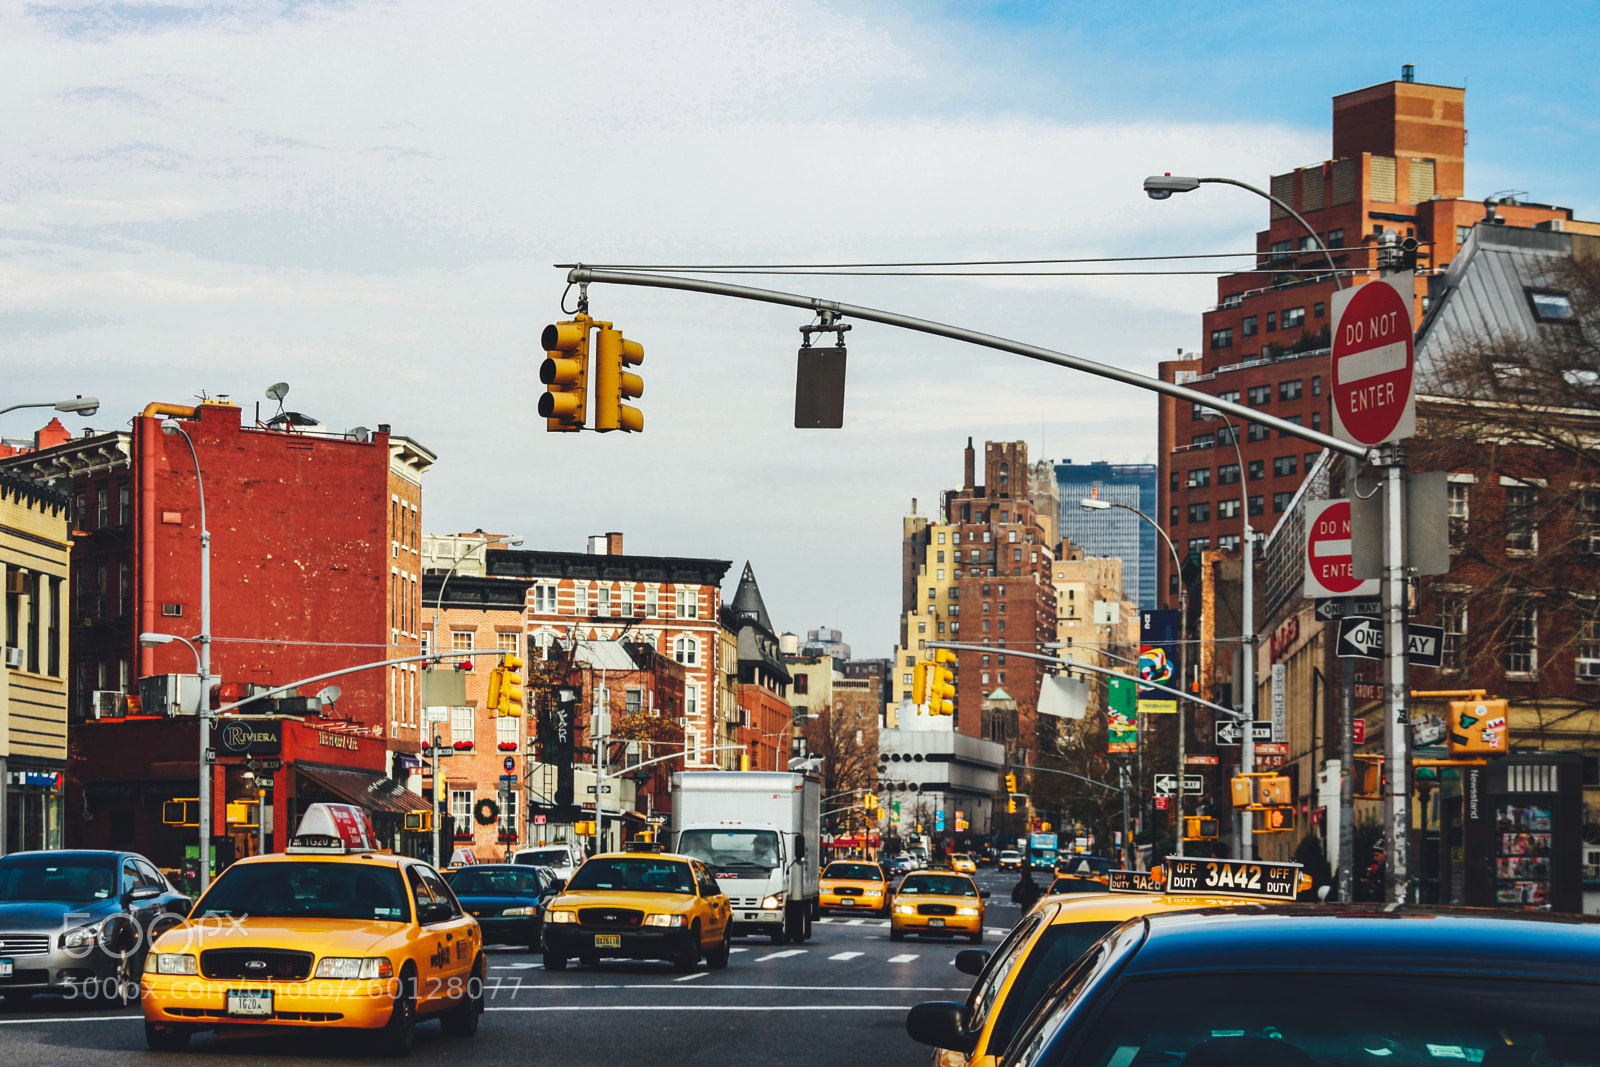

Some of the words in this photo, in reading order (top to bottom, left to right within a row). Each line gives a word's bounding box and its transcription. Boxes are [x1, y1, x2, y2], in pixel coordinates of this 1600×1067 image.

[1346, 321, 1364, 346] DO
[1370, 311, 1397, 340] NOT
[1350, 382, 1395, 413] ENTER
[1320, 521, 1337, 535] DO
[1322, 563, 1353, 578] ENTE
[1324, 604, 1344, 614] ONE
[1356, 603, 1378, 613] WAY
[1355, 629, 1383, 647] ONE
[1408, 637, 1429, 653] AY
[1354, 684, 1374, 699] GROVE
[227, 726, 278, 746] RIVIERA
[1221, 729, 1238, 737] ONE
[1252, 728, 1267, 737] WAY
[1256, 756, 1263, 766] W
[1264, 756, 1270, 766] 4
[1272, 756, 1282, 766] ST
[1470, 769, 1479, 819] Newsstand
[305, 836, 328, 846] 1G20
[1176, 863, 1196, 874] OFF
[1269, 868, 1290, 880] OFF
[1173, 877, 1198, 888] DUTY
[1205, 862, 1262, 890] 3A42
[1112, 880, 1129, 889] DUTY
[1267, 882, 1291, 894] DUTY
